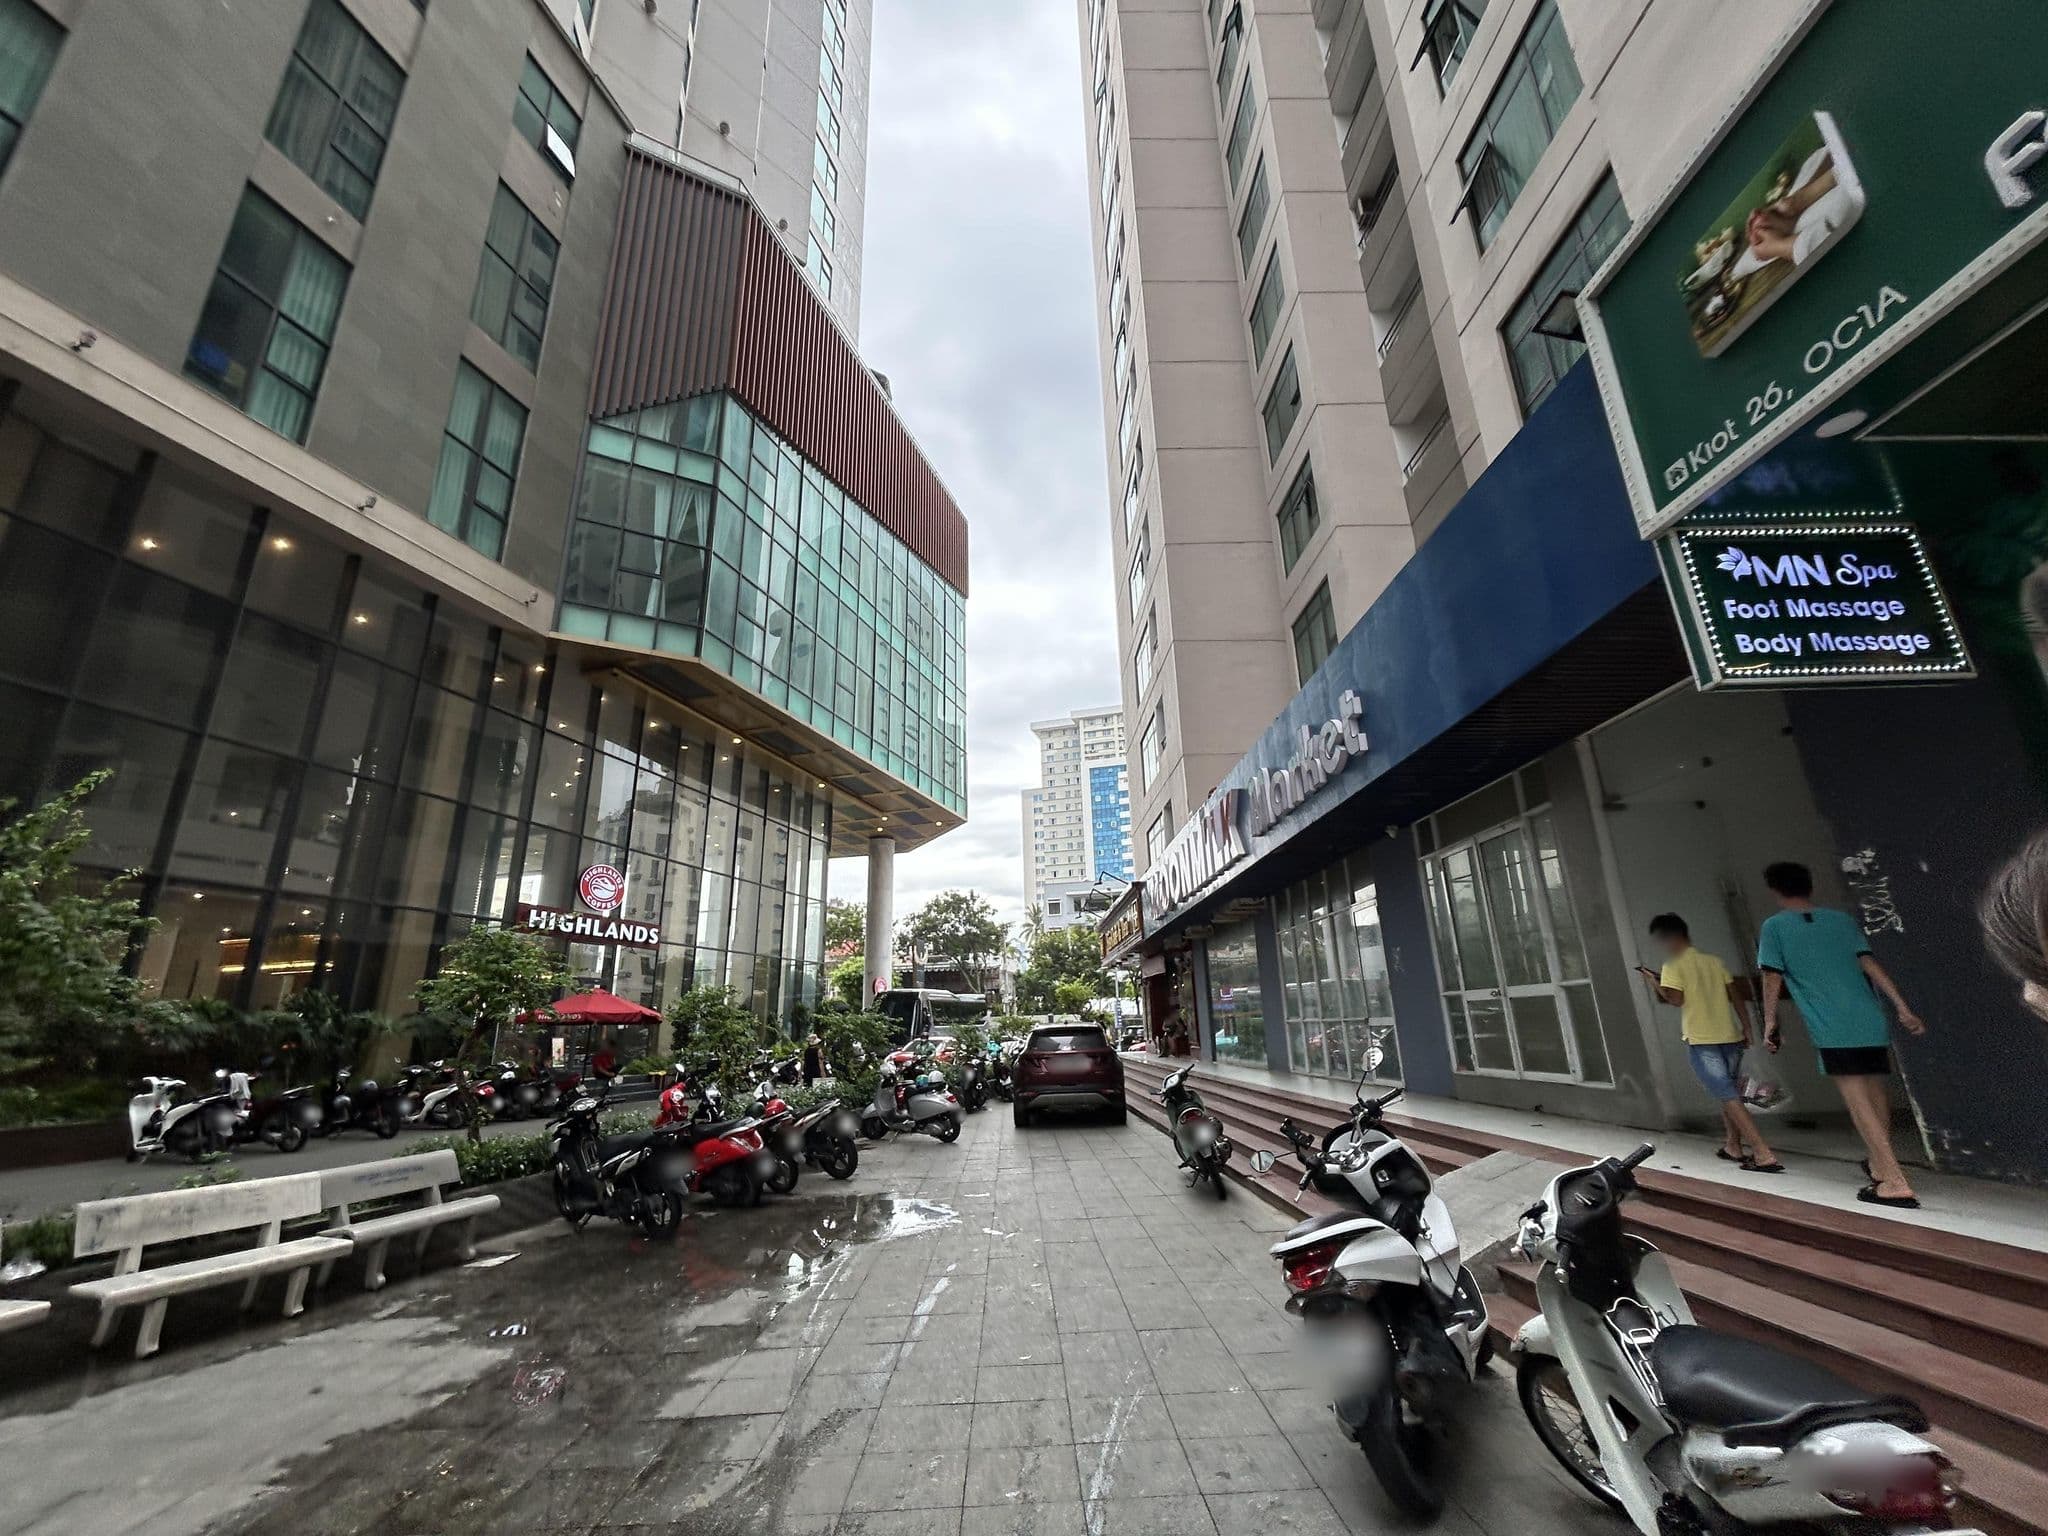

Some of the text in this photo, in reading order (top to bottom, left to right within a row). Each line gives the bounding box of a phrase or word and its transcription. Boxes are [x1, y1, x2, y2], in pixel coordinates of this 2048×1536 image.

[1746, 381, 1795, 426] 26,
[1803, 286, 1908, 374] OC1A
[1751, 553, 1897, 588] MN Spa
[1723, 599, 1906, 621] Foot Massage
[1735, 632, 1931, 656] Body Massage
[584, 867, 624, 890] HIGHLANDS
[586, 895, 617, 909] COFFEE
[528, 909, 660, 945] HIGHLANDS
